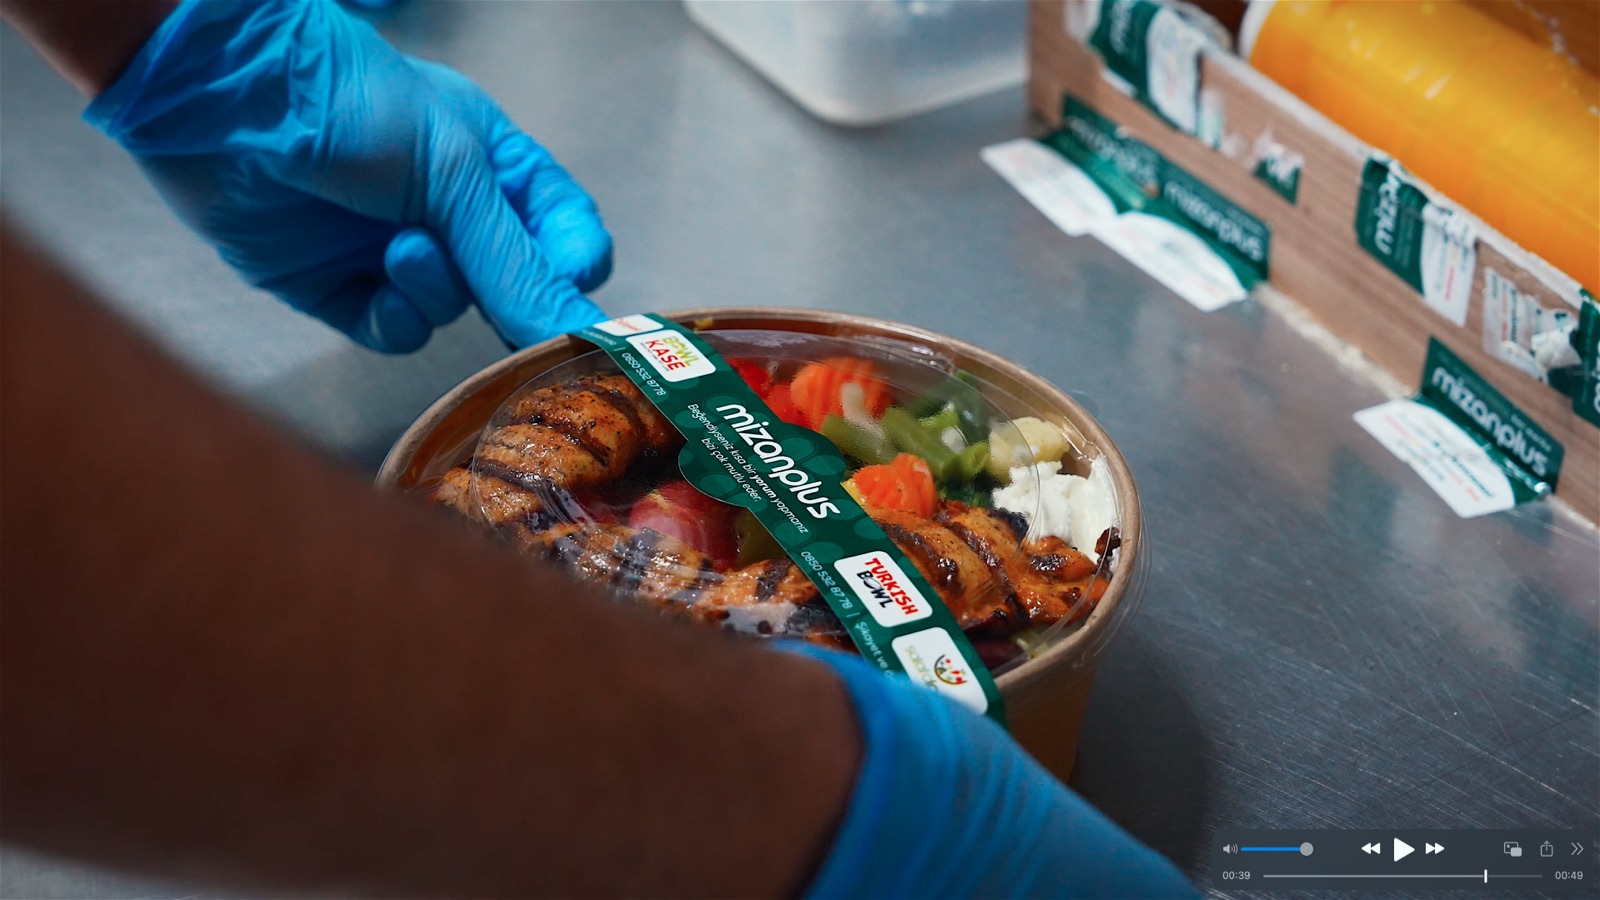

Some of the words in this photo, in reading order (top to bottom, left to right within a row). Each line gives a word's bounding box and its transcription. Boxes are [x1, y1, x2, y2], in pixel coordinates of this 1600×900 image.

[636, 367, 652, 381] 532
[645, 339, 686, 371] KASE
[687, 403, 735, 451] Beğendiyseniz
[1431, 366, 1549, 476] mizanplus
[701, 437, 719, 452] bizi
[710, 449, 729, 464] çok
[723, 461, 747, 484] mutlu
[742, 482, 762, 502] eder.
[715, 403, 841, 519] mizanplus
[729, 449, 747, 465] kısa
[742, 463, 757, 475] bir
[749, 474, 777, 499] yorum
[770, 497, 809, 534] yapmanız
[856, 570, 894, 609] BOWL
[864, 556, 919, 616] TURKISH
[801, 551, 823, 571] 0850
[817, 569, 836, 588] 532
[854, 621, 883, 657] Şikayet
[876, 656, 889, 670] ve
